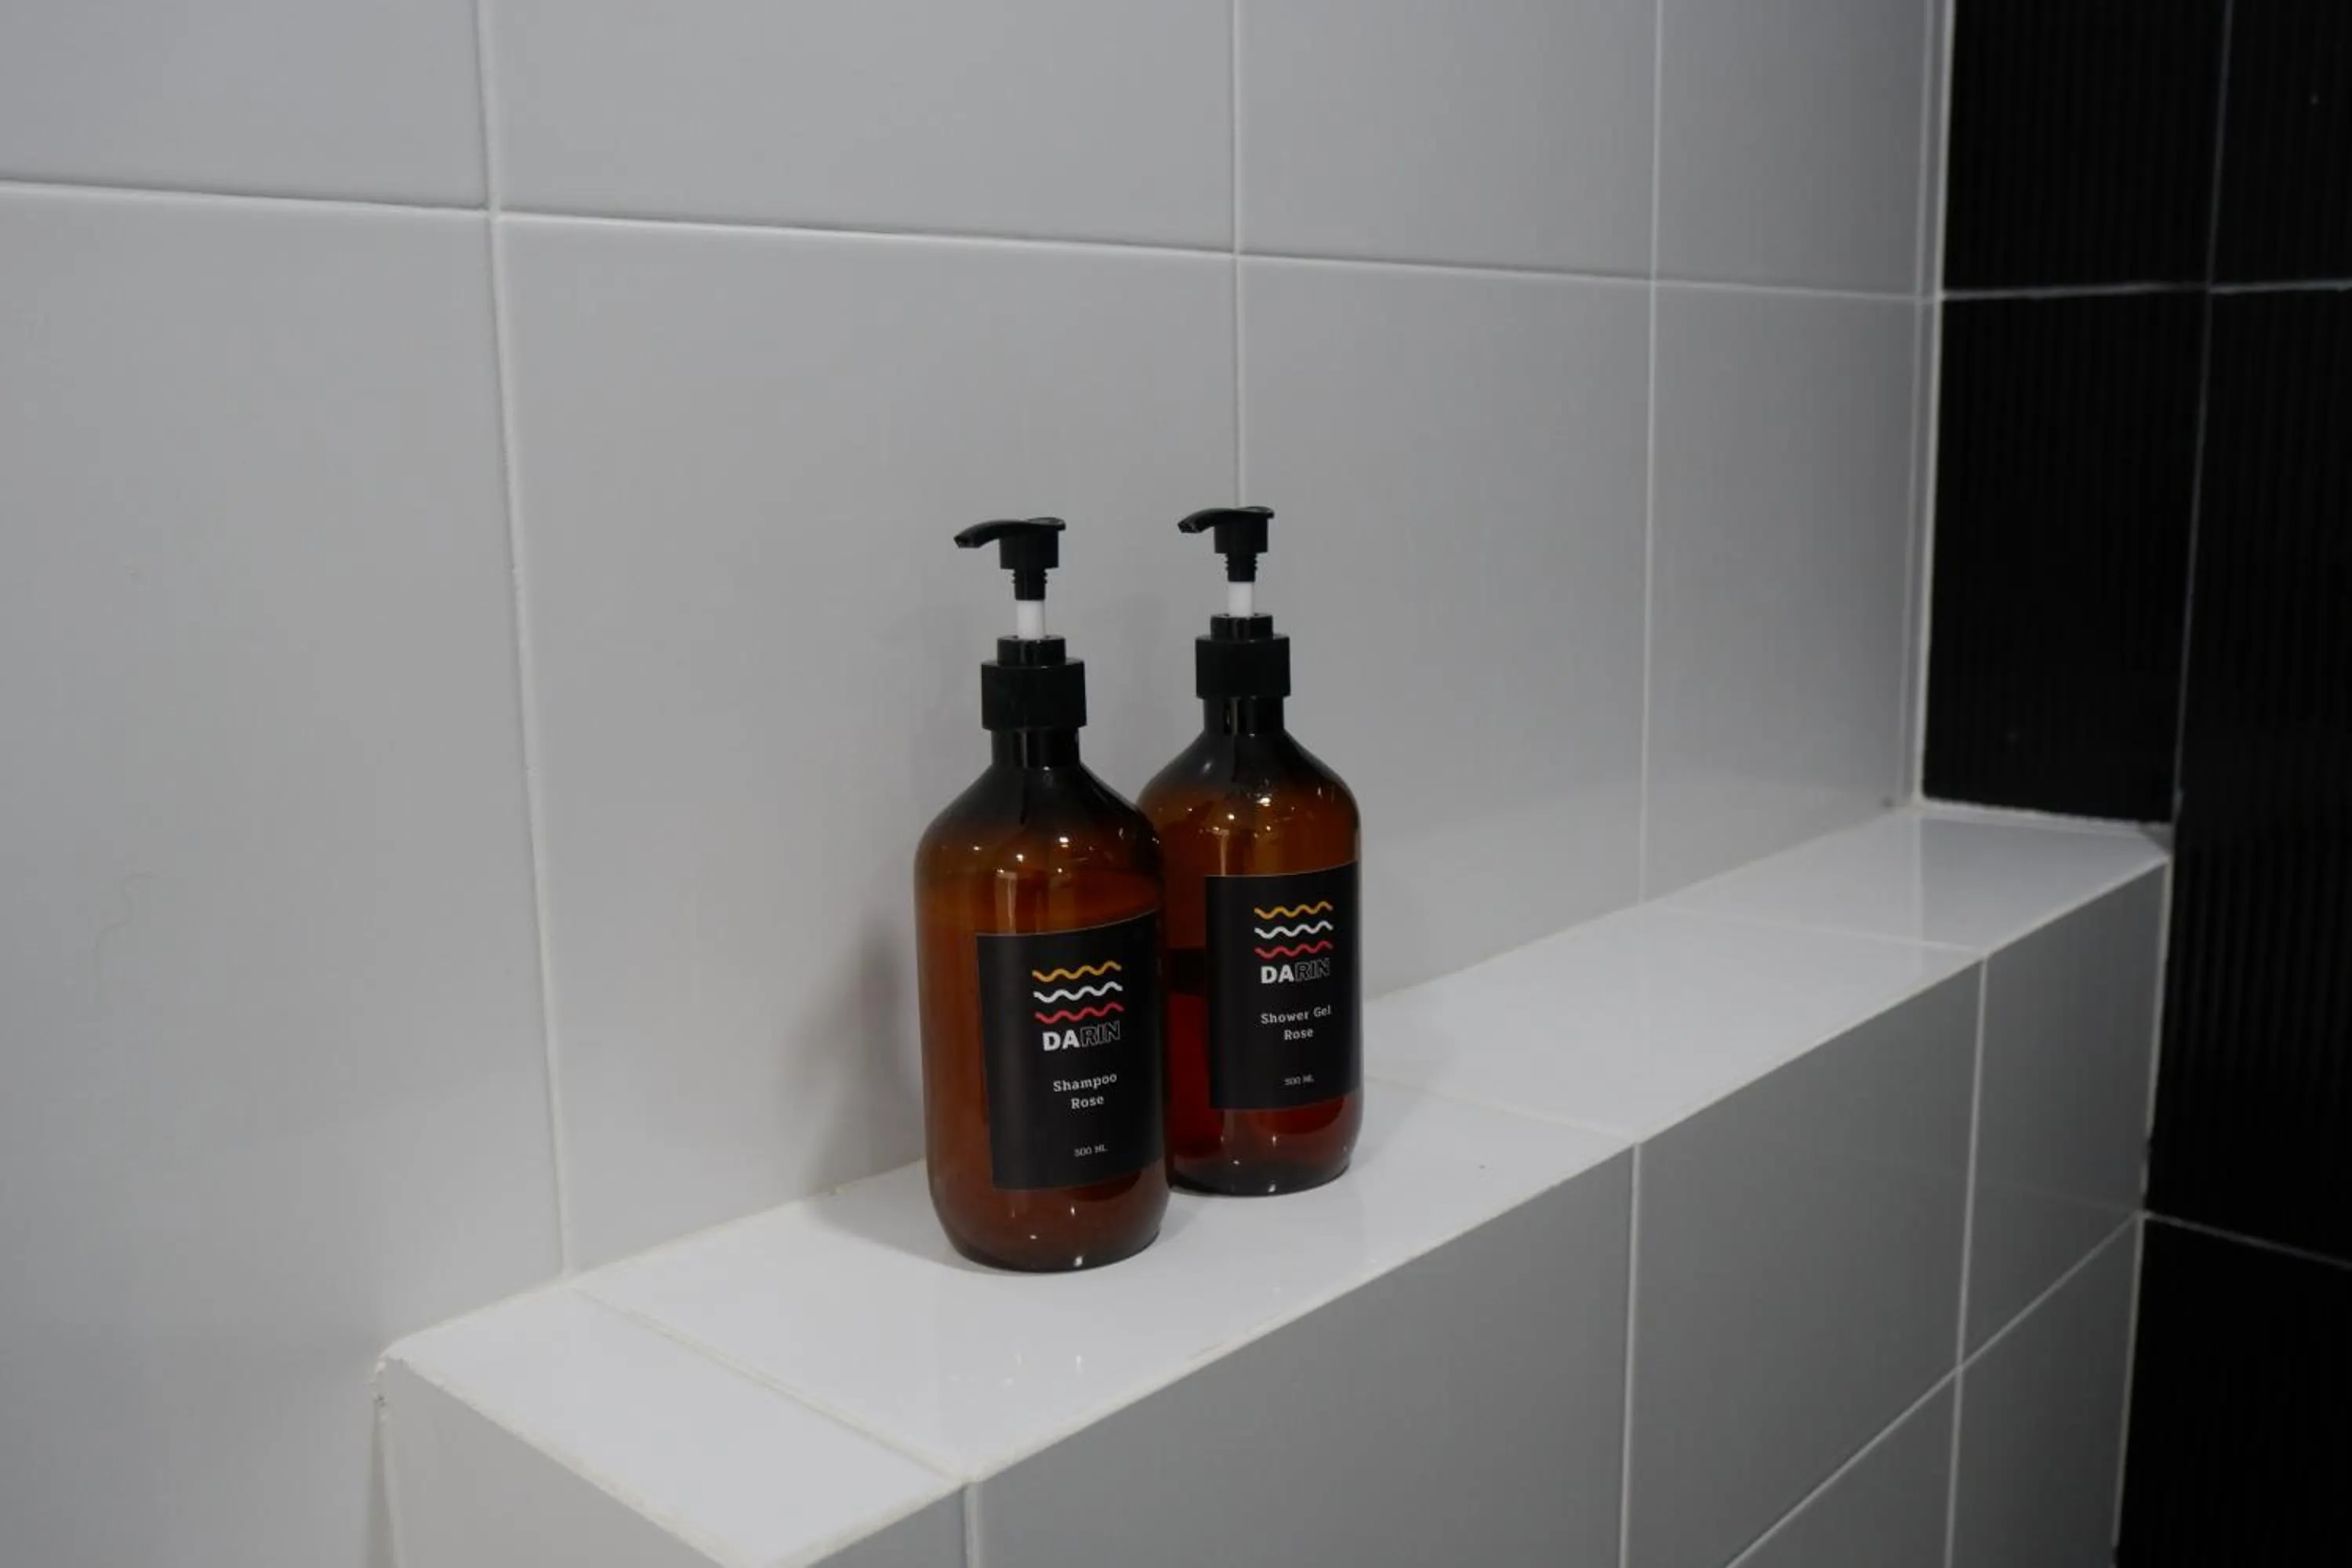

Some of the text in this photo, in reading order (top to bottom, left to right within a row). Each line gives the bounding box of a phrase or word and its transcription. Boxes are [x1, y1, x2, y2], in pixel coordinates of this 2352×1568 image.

[1261, 957, 1330, 984] DARIN
[1261, 1005, 1331, 1024] Shower Gel
[1042, 1021, 1120, 1051] DARIN
[1283, 1029, 1314, 1040] Rose
[1053, 1073, 1117, 1092] Shampoo
[1071, 1096, 1105, 1109] Rose
